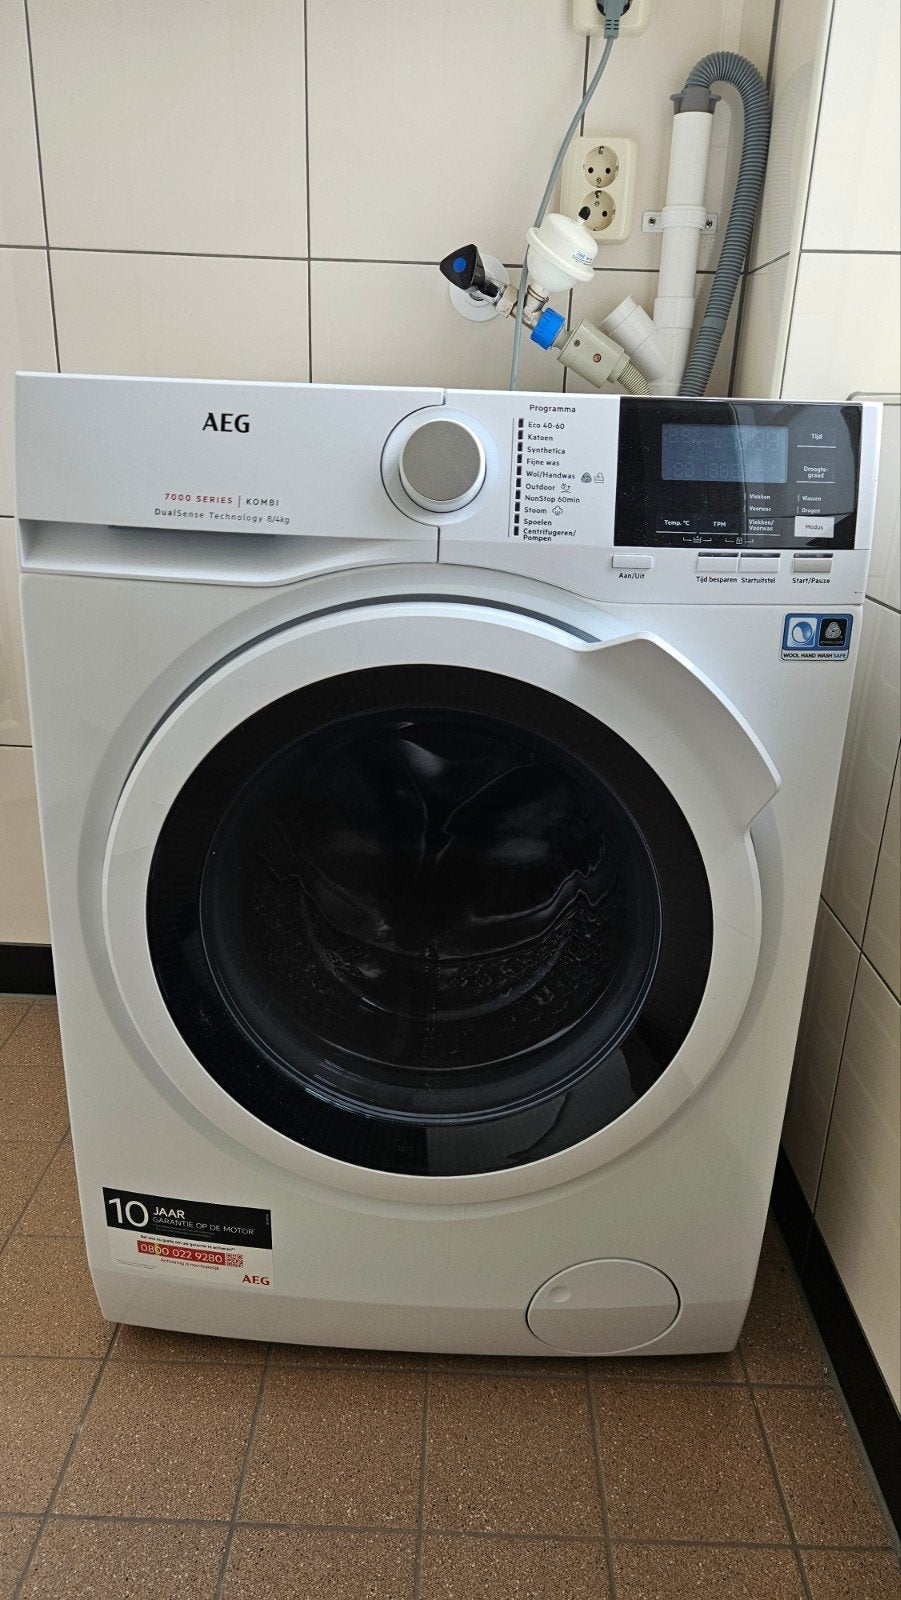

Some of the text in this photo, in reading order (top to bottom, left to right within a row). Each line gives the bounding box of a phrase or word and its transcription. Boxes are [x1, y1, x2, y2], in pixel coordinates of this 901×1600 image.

[530, 404, 576, 413] Programma
[203, 413, 249, 433] AEG
[526, 471, 575, 479] Wol/Handwas
[165, 493, 232, 504] 7000 SERIES
[246, 498, 279, 506] KOMBI
[155, 509, 289, 524] DualSense Technology 8/4kg
[664, 519, 681, 527] Temp.
[709, 576, 737, 584] besparen
[108, 1198, 149, 1228] 10
[153, 1206, 185, 1219] JAAR
[153, 1217, 193, 1228] GARANTIE
[141, 1243, 223, 1263] 0800 022 9280
[242, 1275, 269, 1285] AEG
